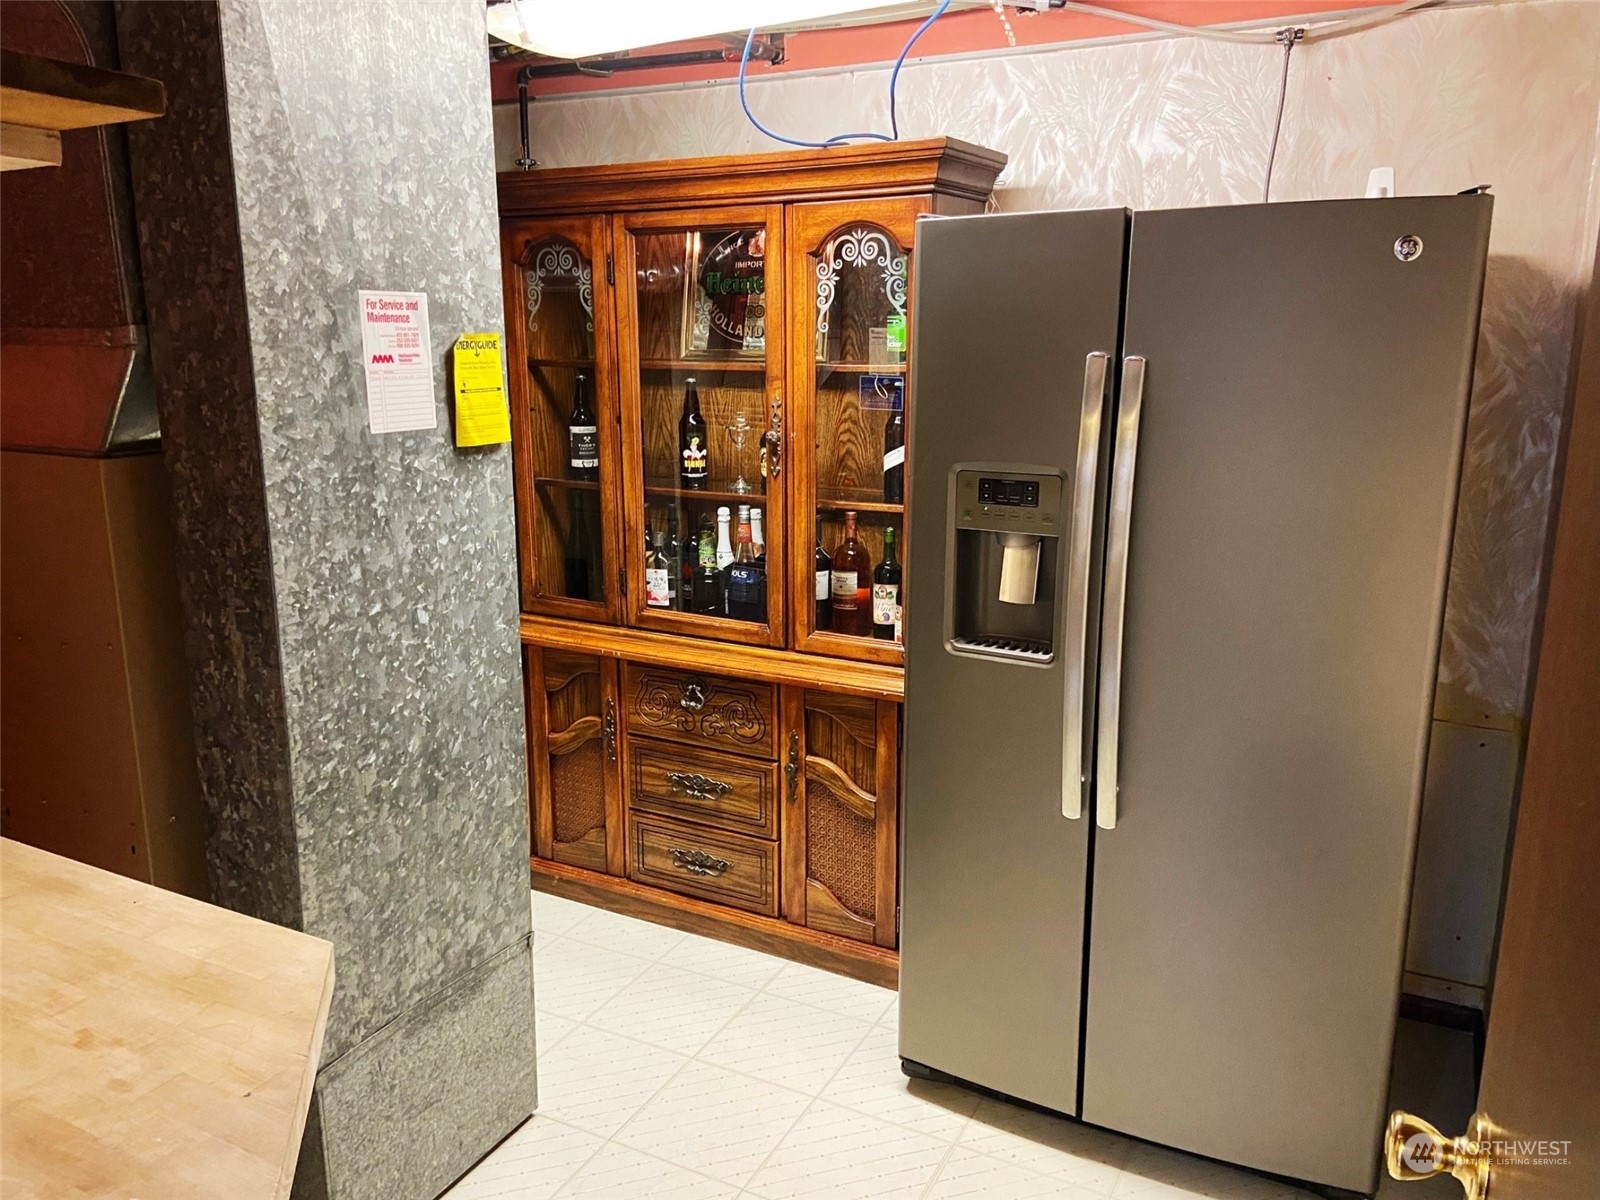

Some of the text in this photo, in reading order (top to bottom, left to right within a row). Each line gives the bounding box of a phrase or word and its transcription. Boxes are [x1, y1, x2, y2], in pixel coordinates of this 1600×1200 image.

[735, 261, 765, 269] IMPOR
[366, 298, 419, 311] For Service and
[366, 311, 411, 323] Maintenance
[711, 305, 764, 338] HOLLAND
